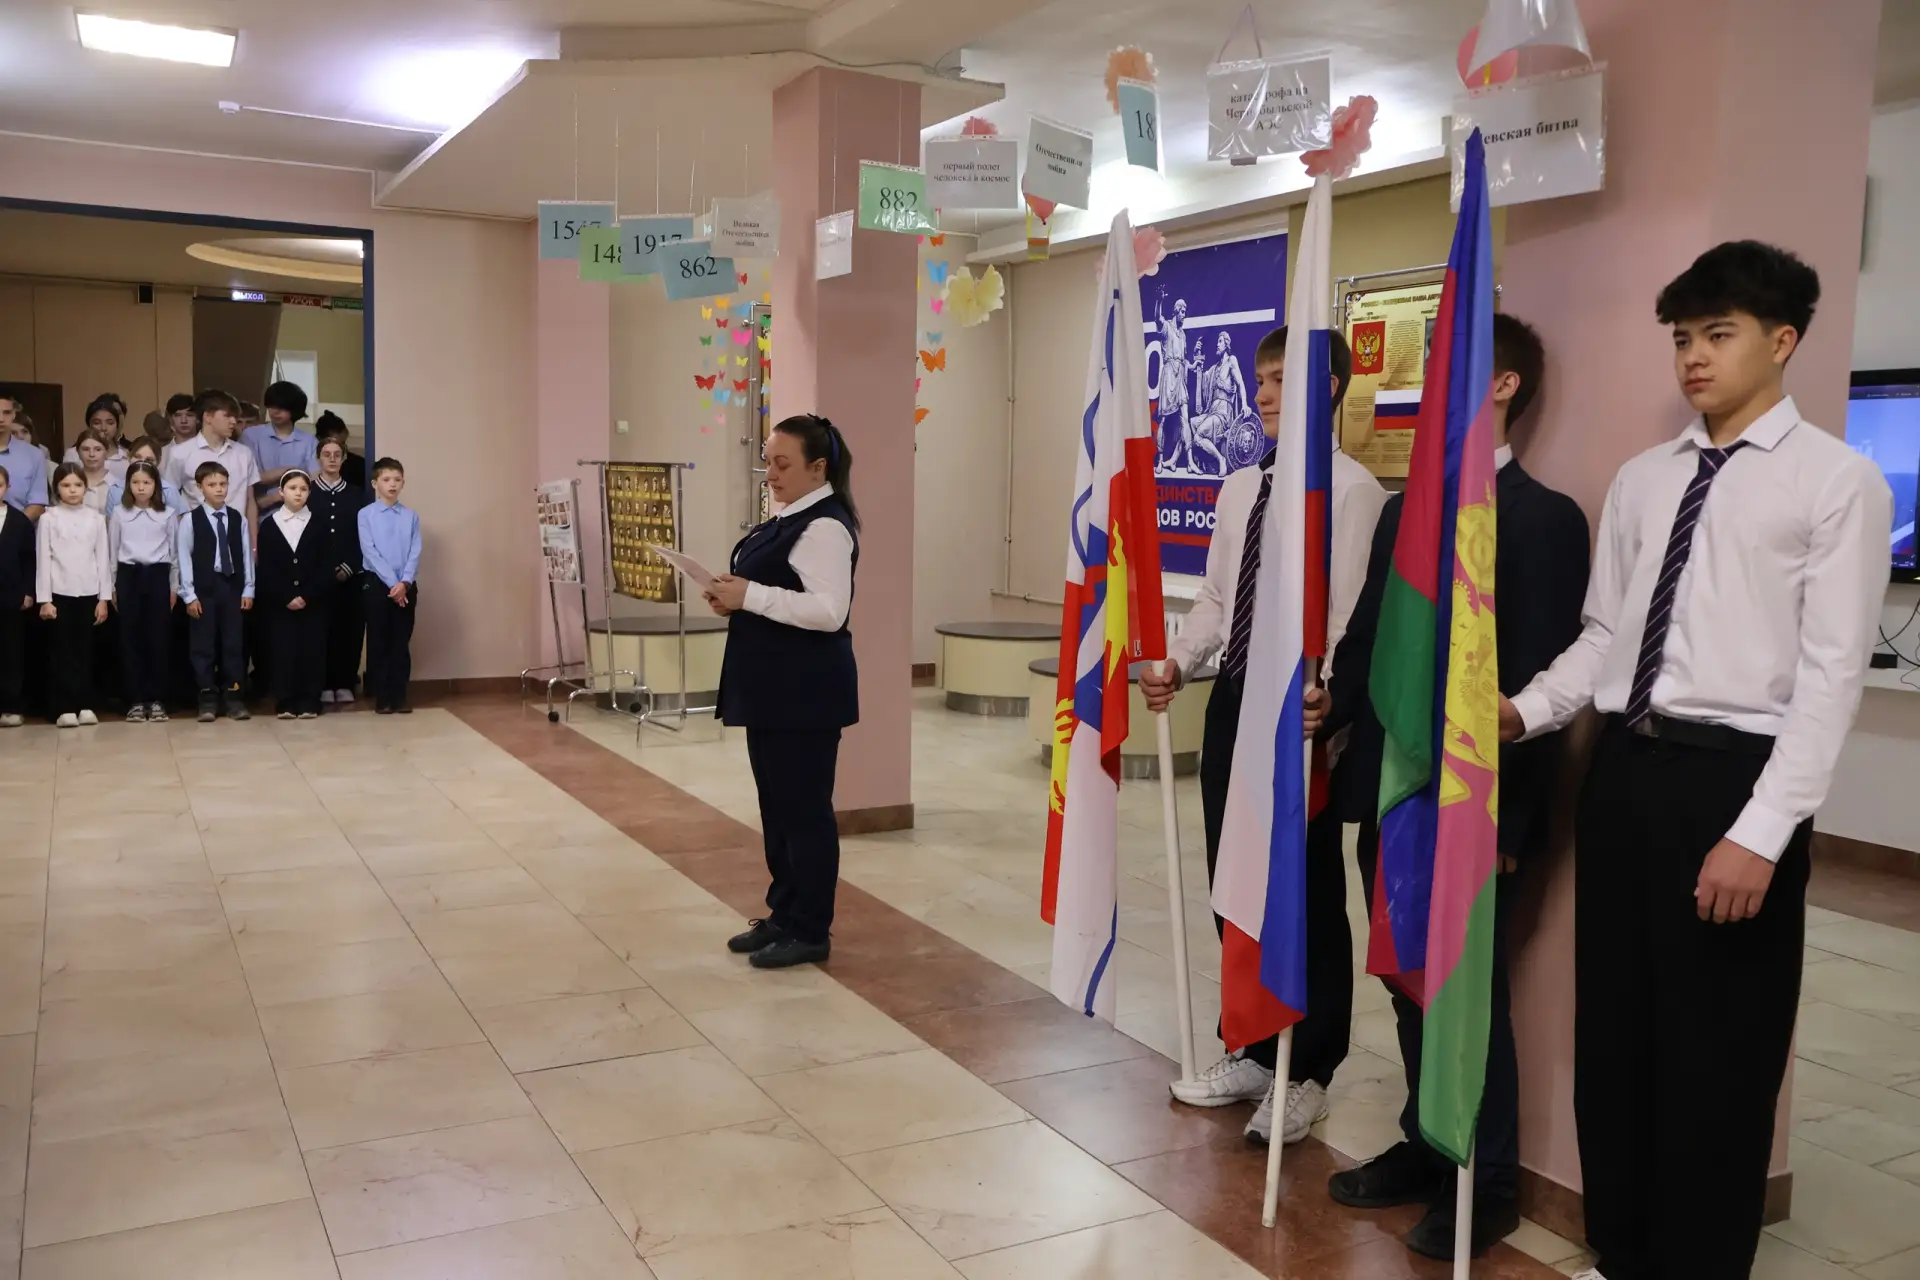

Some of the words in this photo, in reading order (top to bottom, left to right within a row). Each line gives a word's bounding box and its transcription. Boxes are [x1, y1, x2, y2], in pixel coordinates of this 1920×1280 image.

[1482, 127, 1532, 145] евская
[1536, 118, 1579, 135] битва
[942, 161, 975, 172] первый
[977, 163, 1001, 171] полет
[933, 174, 972, 182] человека
[980, 175, 1011, 183] космос
[880, 186, 917, 213] 882
[680, 256, 718, 279] 862
[233, 289, 264, 301] ЫХОД
[289, 295, 315, 306] УРОК
[1156, 484, 1221, 505] ДИНСТВ
